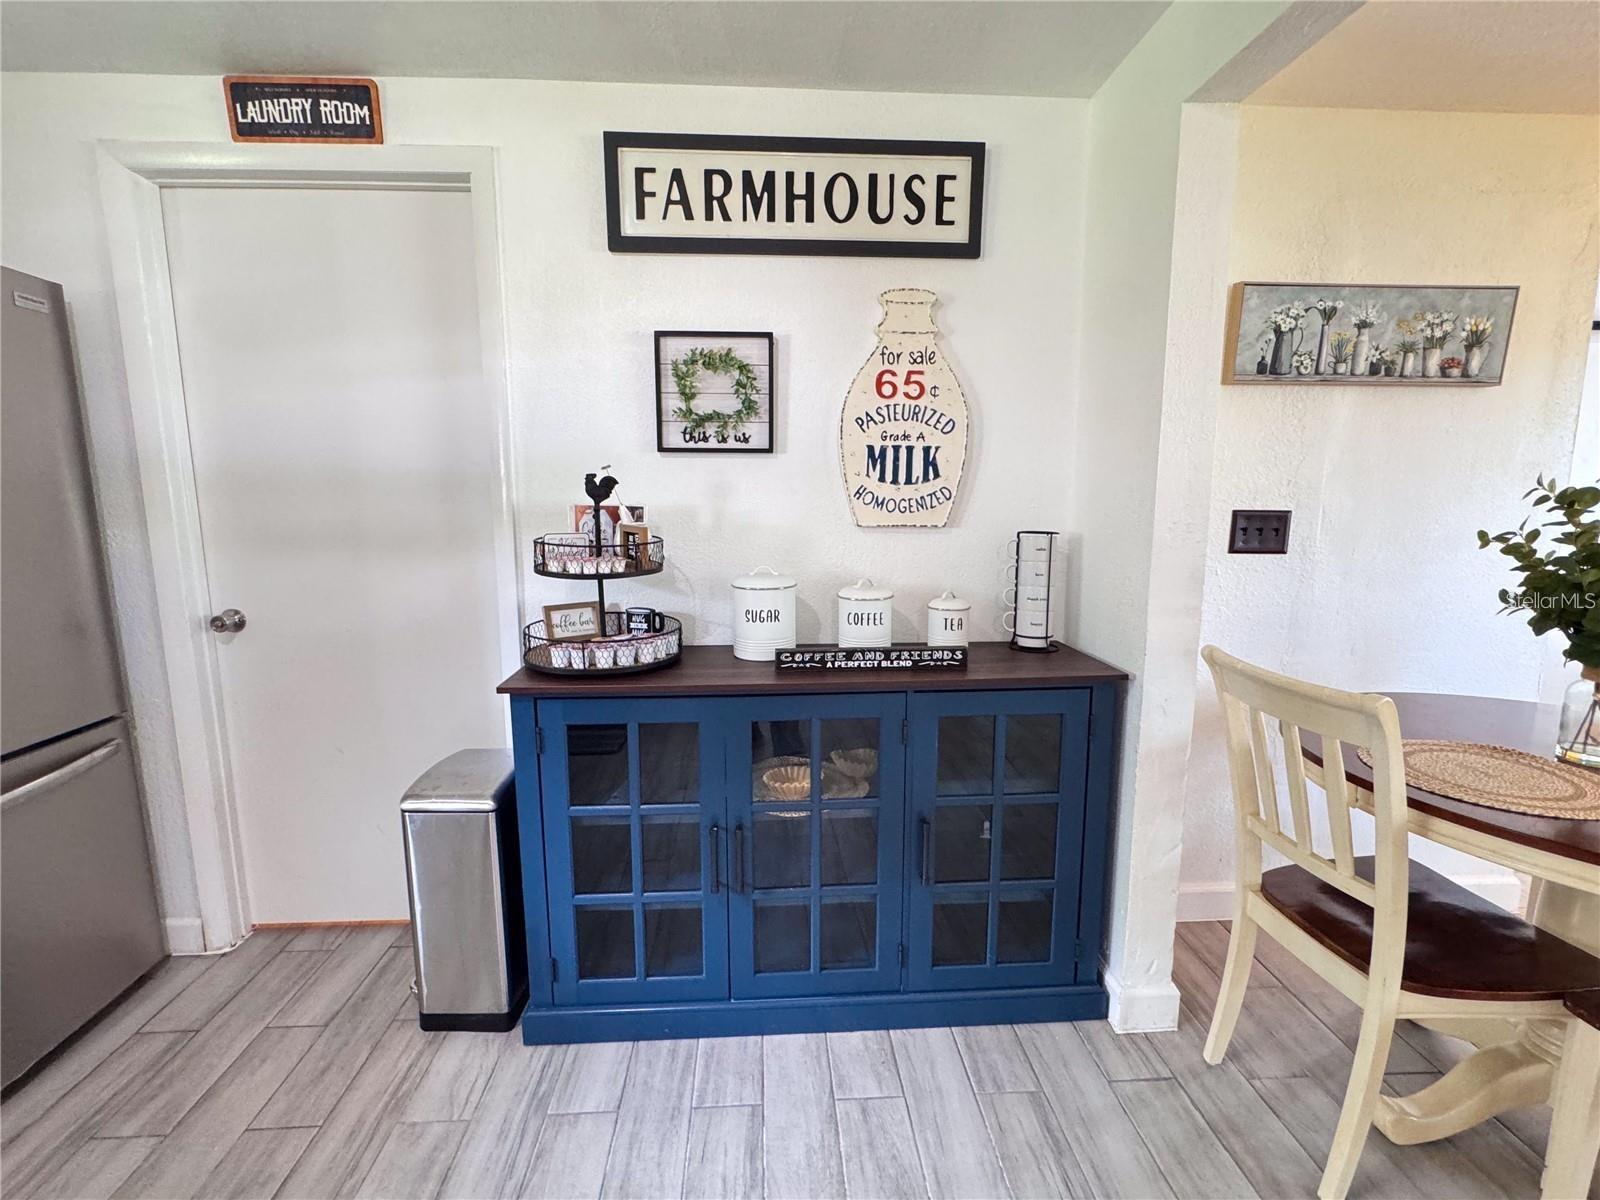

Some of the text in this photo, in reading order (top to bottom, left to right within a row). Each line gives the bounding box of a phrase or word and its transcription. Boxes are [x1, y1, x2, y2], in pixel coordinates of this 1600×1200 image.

[235, 98, 371, 125] LAUNDRY ROOM
[633, 166, 957, 226] FARMHOUSE
[879, 345, 937, 366] for sale
[854, 403, 956, 436] PASTEURIZED
[680, 426, 752, 444] this is us
[880, 430, 926, 443] Grade A
[865, 444, 942, 486] MILK
[853, 484, 953, 514] HOMOGENIZED
[552, 611, 594, 632] coffee bar
[744, 609, 781, 623] SUGAR
[846, 611, 884, 626] COFFEE
[943, 617, 963, 632] TEA
[780, 650, 963, 662] COFFEE AND FRIENDS
[826, 660, 913, 669] A PERFECT BLEND
